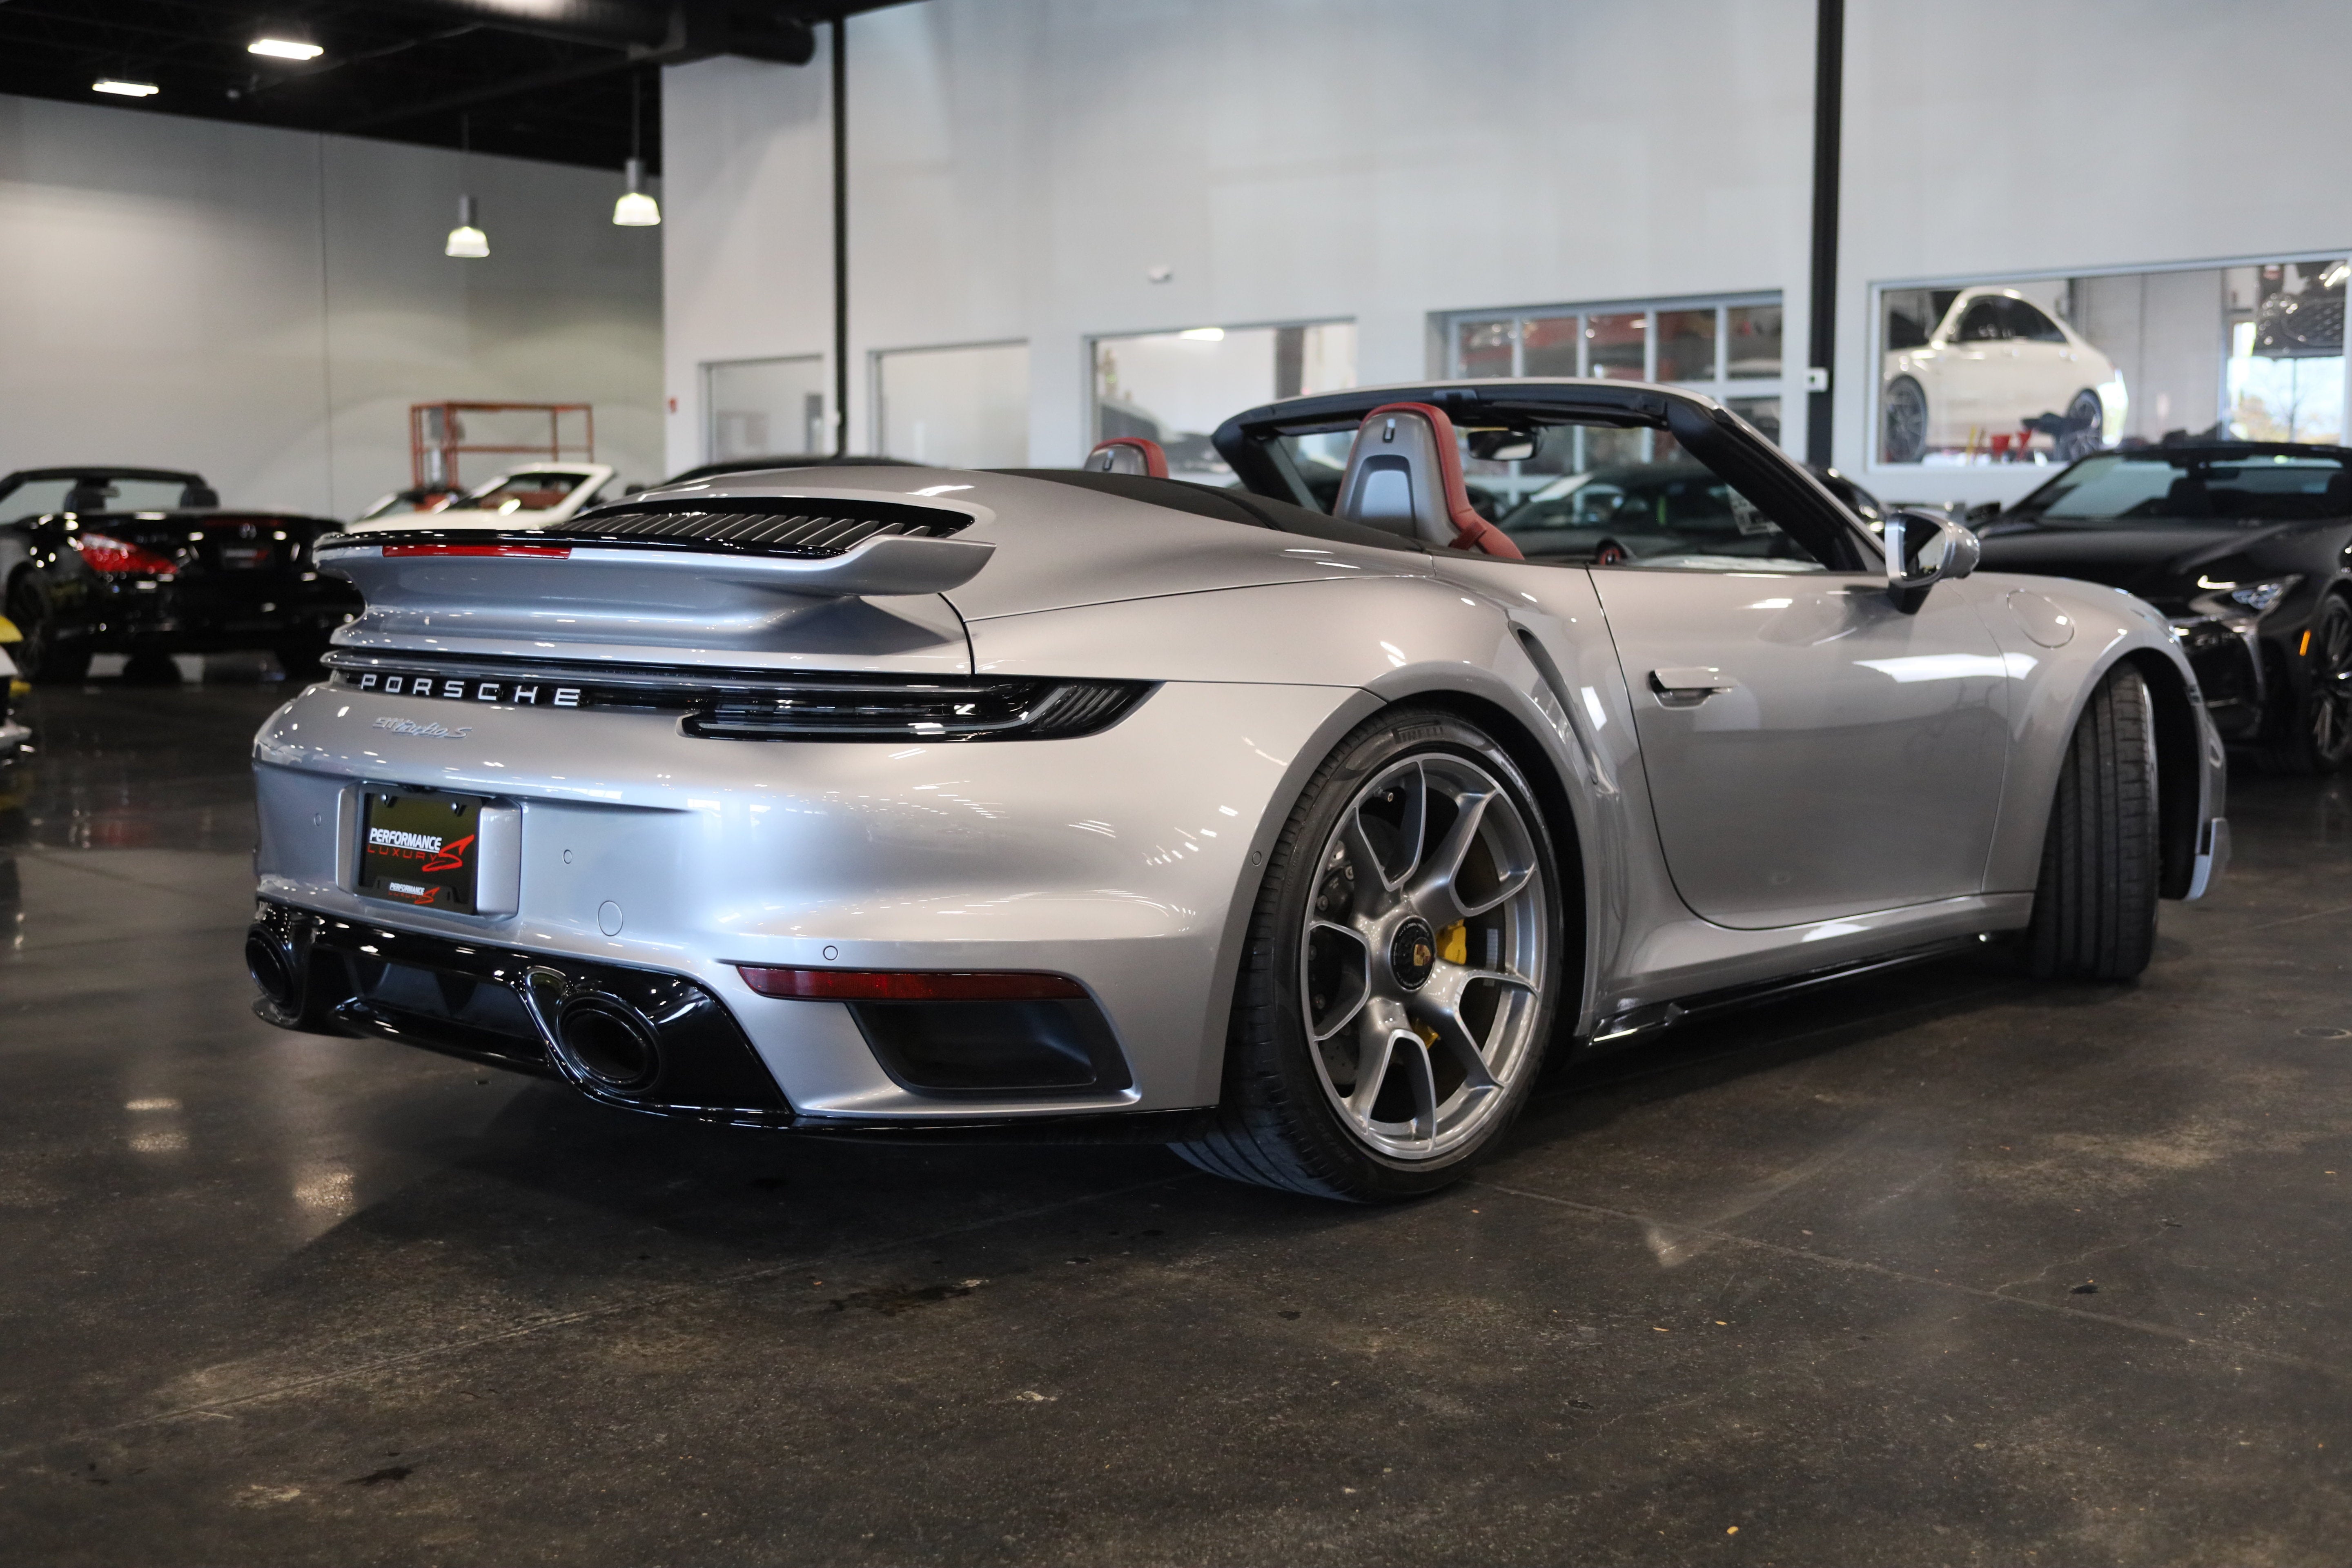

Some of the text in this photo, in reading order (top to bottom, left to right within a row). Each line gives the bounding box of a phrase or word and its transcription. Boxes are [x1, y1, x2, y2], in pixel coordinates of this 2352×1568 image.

[361, 674, 580, 706] PORSCHE
[445, 726, 473, 738] S
[1391, 720, 1443, 744] PIRELLI
[370, 827, 442, 851] PERFORMANCE
[368, 844, 438, 862] LUXURY
[390, 882, 425, 895] PERFORMANCE
